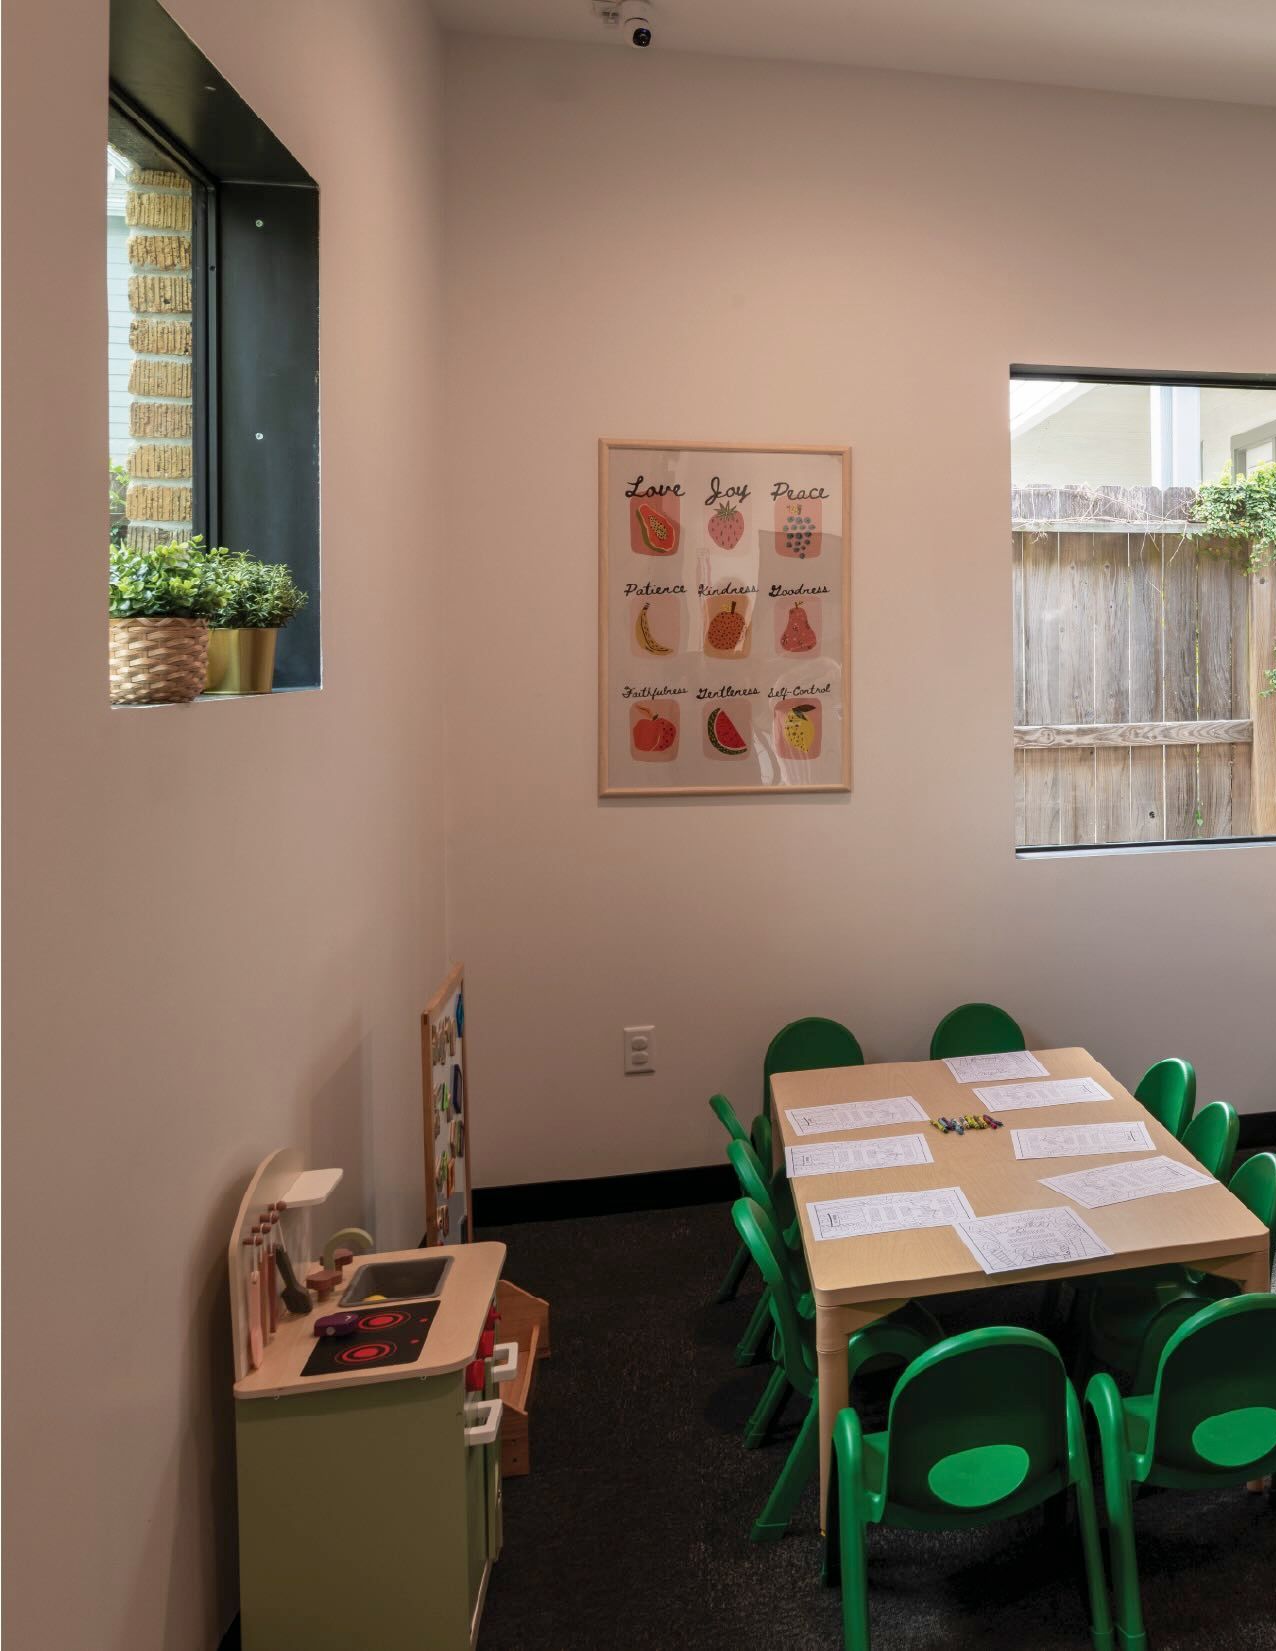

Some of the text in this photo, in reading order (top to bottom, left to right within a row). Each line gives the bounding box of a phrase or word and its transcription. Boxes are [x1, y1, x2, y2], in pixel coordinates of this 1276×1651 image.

[625, 475, 686, 498] Love
[704, 476, 751, 506] Joy
[771, 482, 830, 501] Peace
[624, 583, 687, 597] Patience
[697, 583, 760, 596] Kindness
[768, 584, 831, 598] Goodness
[622, 685, 688, 700] Faithfulness
[696, 685, 760, 700] Gentleness
[767, 684, 832, 699] Self-Control
